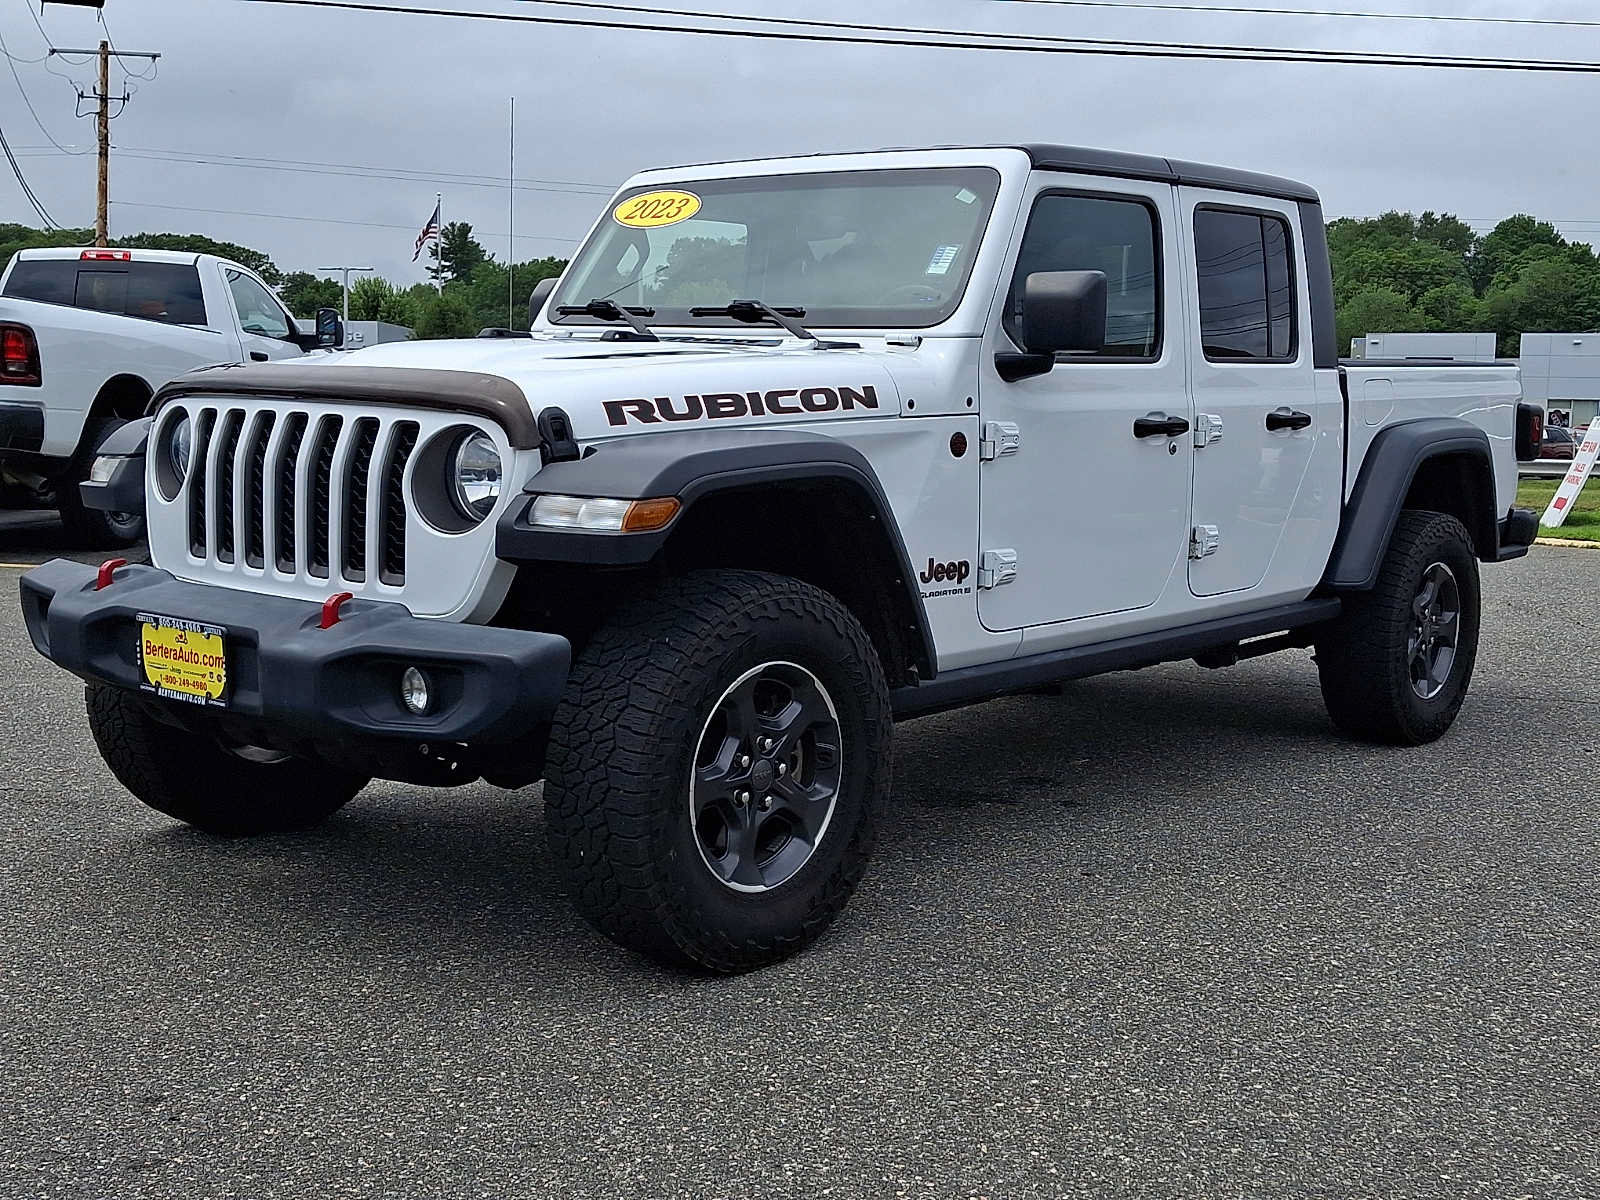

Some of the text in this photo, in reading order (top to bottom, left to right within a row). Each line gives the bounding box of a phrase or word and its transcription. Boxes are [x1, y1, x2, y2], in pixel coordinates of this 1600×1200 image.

[624, 198, 690, 220] 2023
[602, 385, 880, 427] RUBICON
[919, 557, 970, 584] Jeep
[145, 640, 224, 668] BerteraAuto.com
